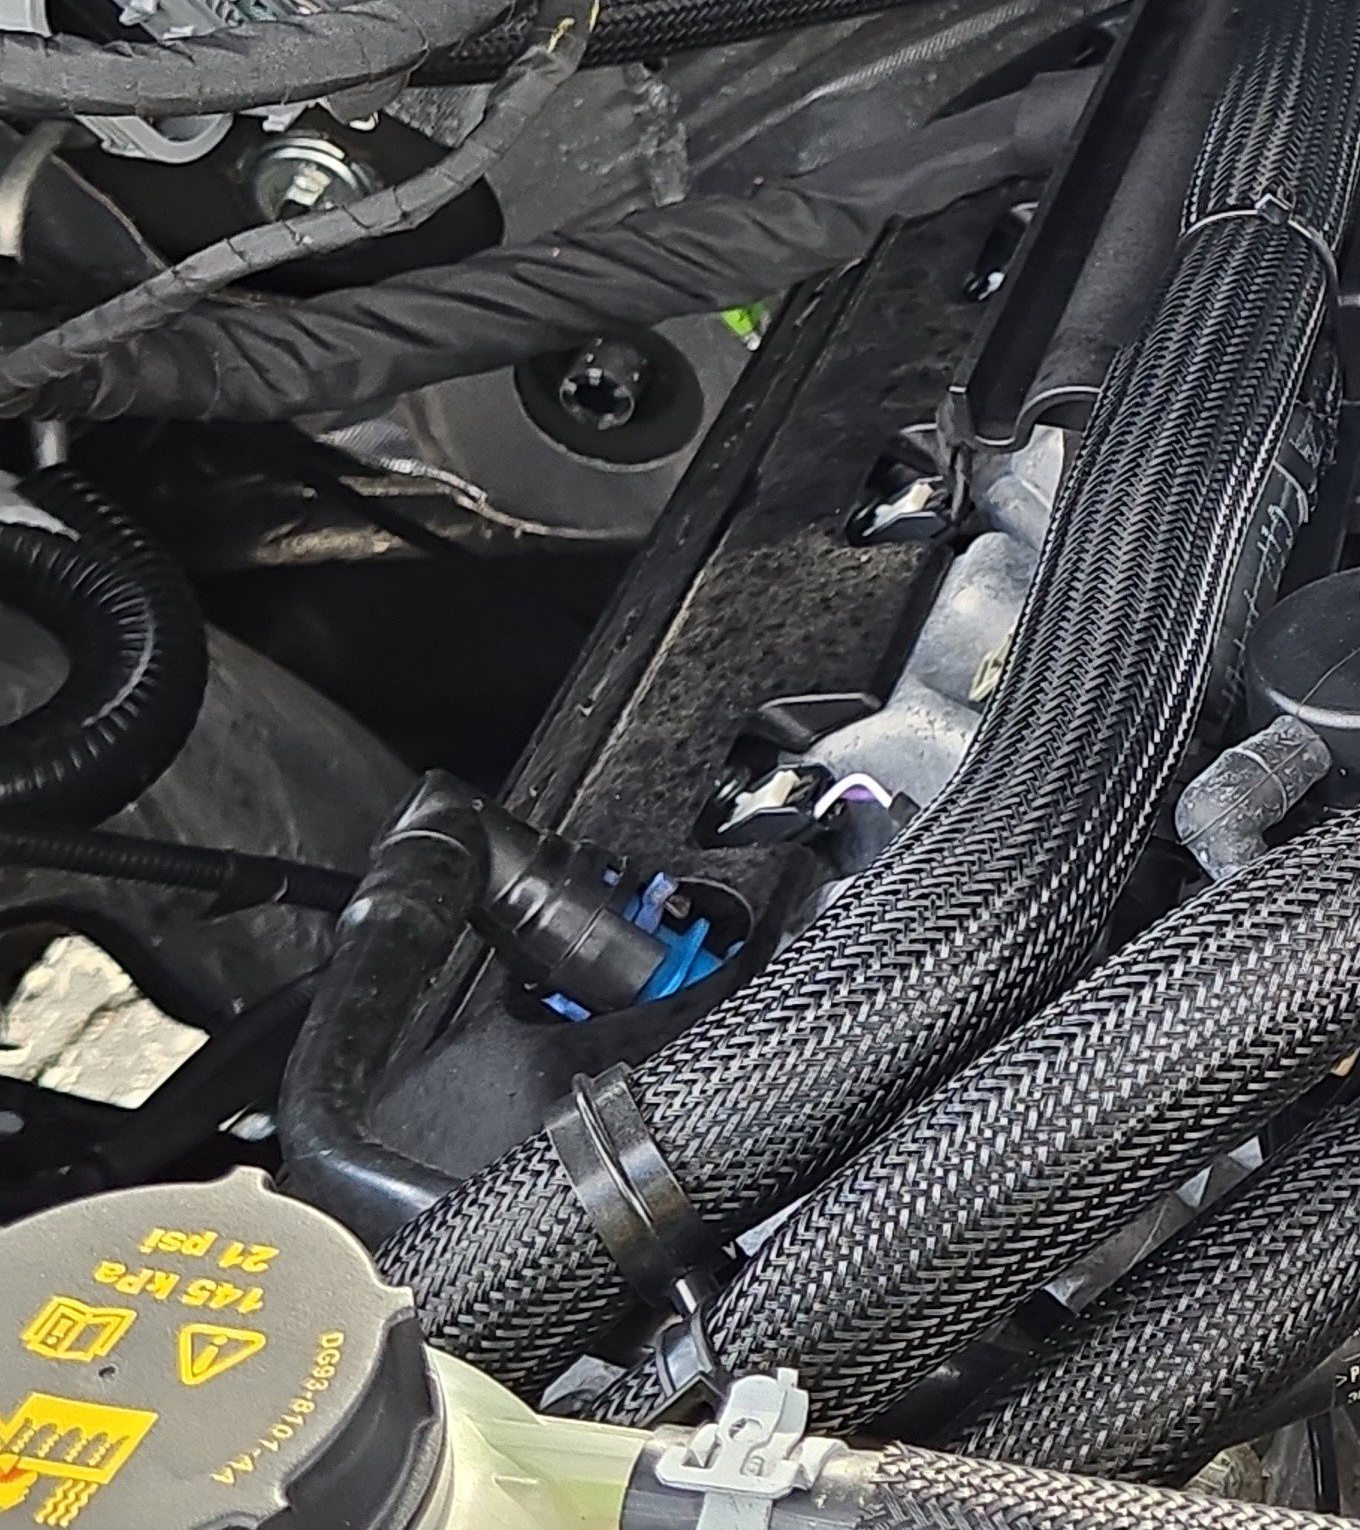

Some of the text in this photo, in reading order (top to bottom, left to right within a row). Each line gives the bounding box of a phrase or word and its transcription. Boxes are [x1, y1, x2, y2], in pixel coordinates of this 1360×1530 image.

[138, 1227, 280, 1272] 21 psi
[93, 1260, 265, 1315] 145 kPa
[211, 1330, 346, 1485] DG93-8101-AA
